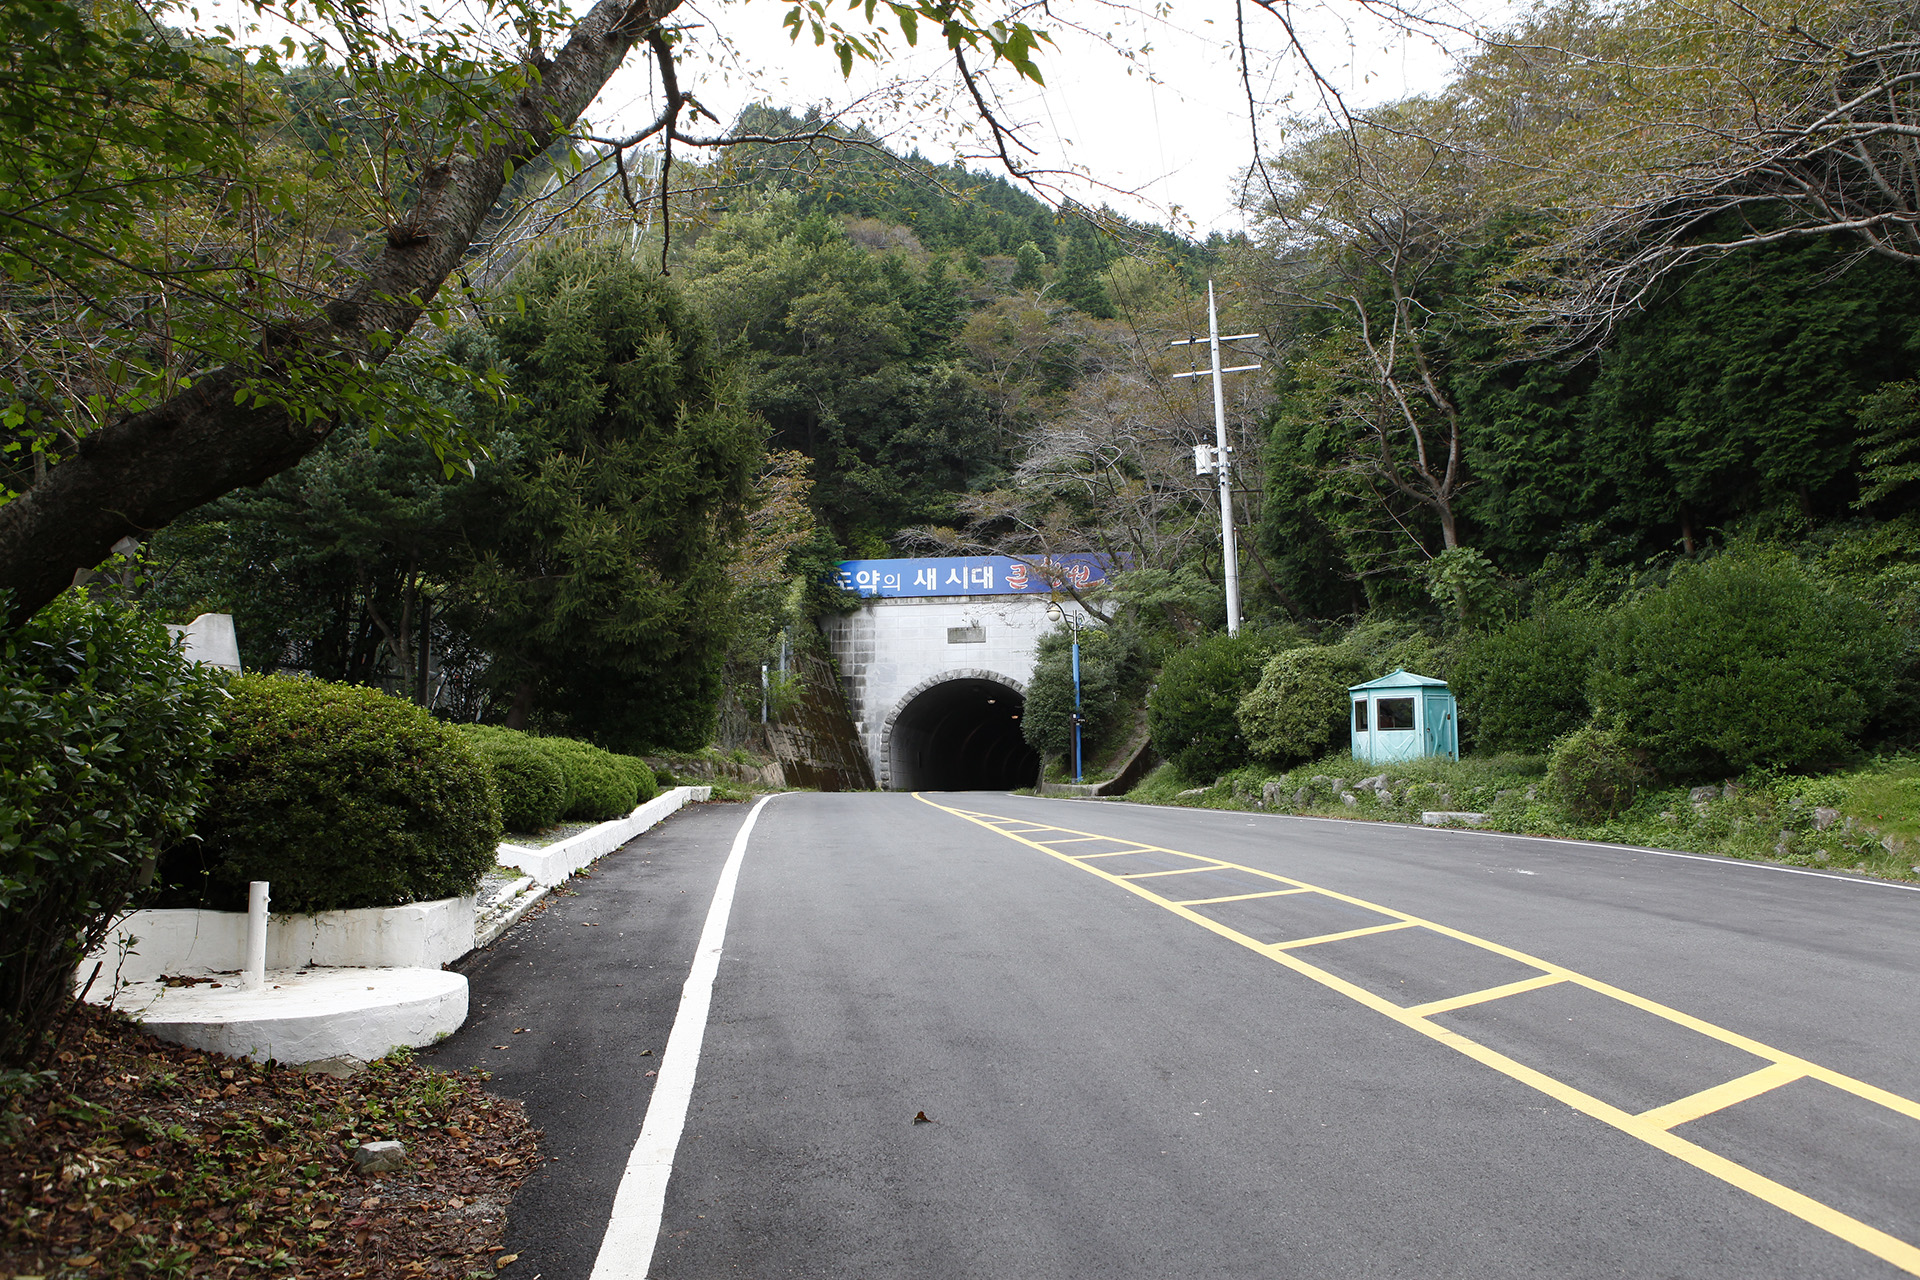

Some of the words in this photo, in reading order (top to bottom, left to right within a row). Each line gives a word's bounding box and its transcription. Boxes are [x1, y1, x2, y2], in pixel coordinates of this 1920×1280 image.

[833, 570, 900, 594] 도약의
[913, 568, 936, 590] 새
[945, 566, 994, 589] 시대
[1005, 564, 1028, 589] 큰
